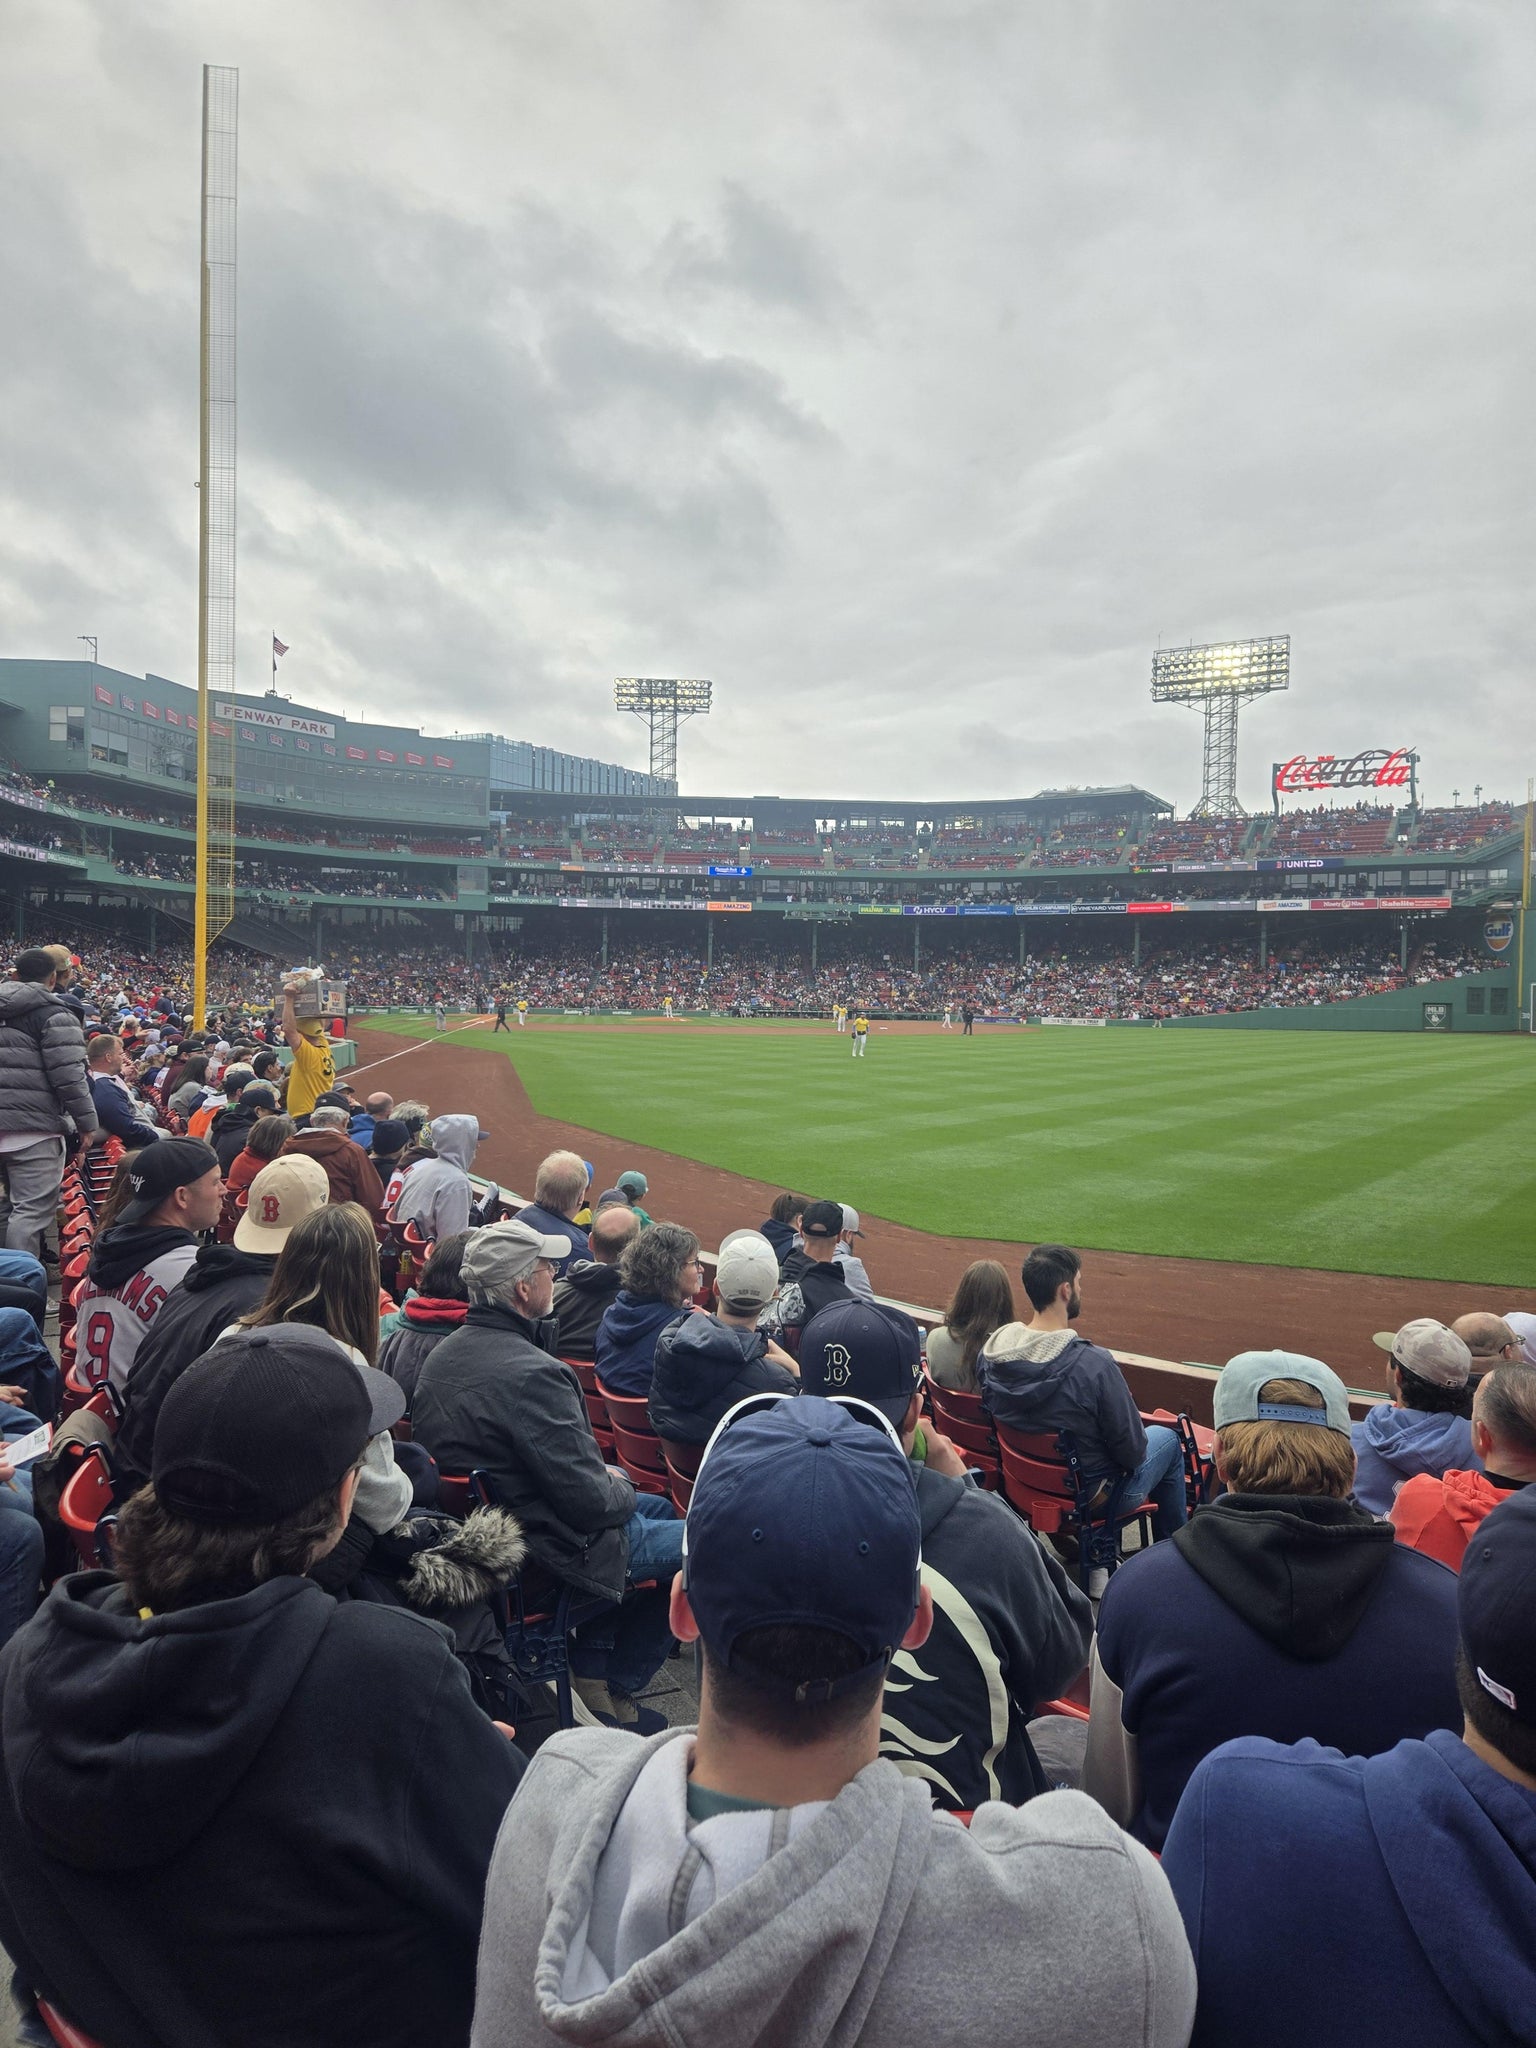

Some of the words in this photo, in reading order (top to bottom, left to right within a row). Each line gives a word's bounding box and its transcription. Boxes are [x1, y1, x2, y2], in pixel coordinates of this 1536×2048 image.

[223, 706, 283, 726] FENWAY
[291, 719, 329, 735] PARK
[1286, 859, 1324, 868] UNITED
[1485, 922, 1512, 938] Gulf
[261, 1195, 280, 1223] B
[85, 1311, 115, 1387] 9
[823, 1343, 852, 1388] B
[1070, 1457, 1077, 1465] D
